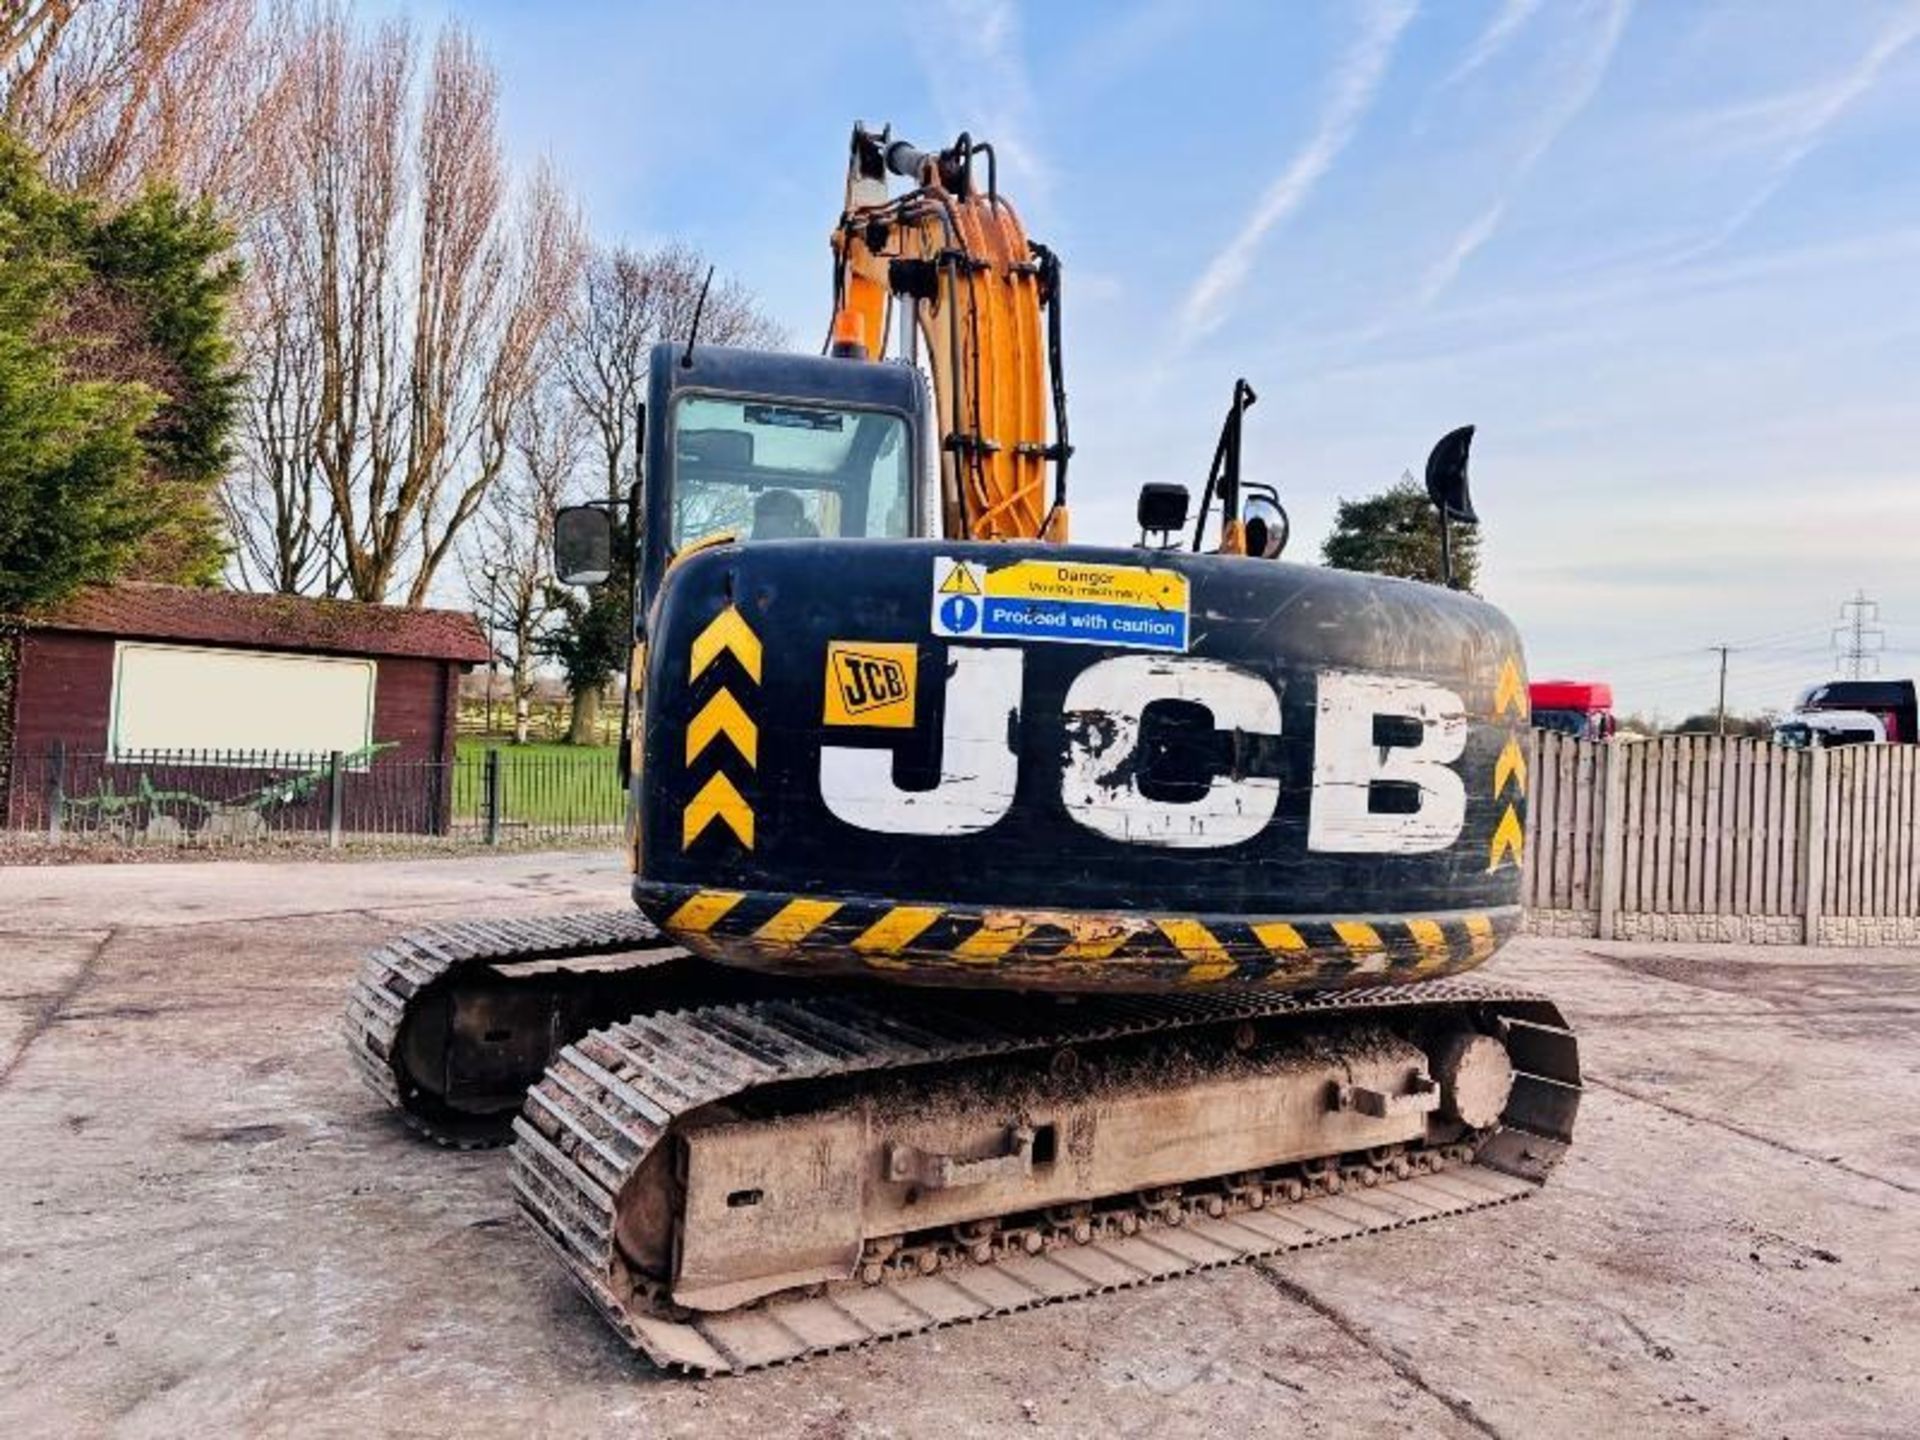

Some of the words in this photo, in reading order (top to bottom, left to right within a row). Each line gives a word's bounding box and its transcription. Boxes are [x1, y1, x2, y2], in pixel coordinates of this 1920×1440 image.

[1057, 568, 1114, 586] Danger
[992, 608, 1066, 628] Proceed
[1071, 613, 1108, 630] with
[1112, 617, 1175, 637] caution
[845, 658, 902, 706] JCB
[819, 647, 1469, 854] JCB
